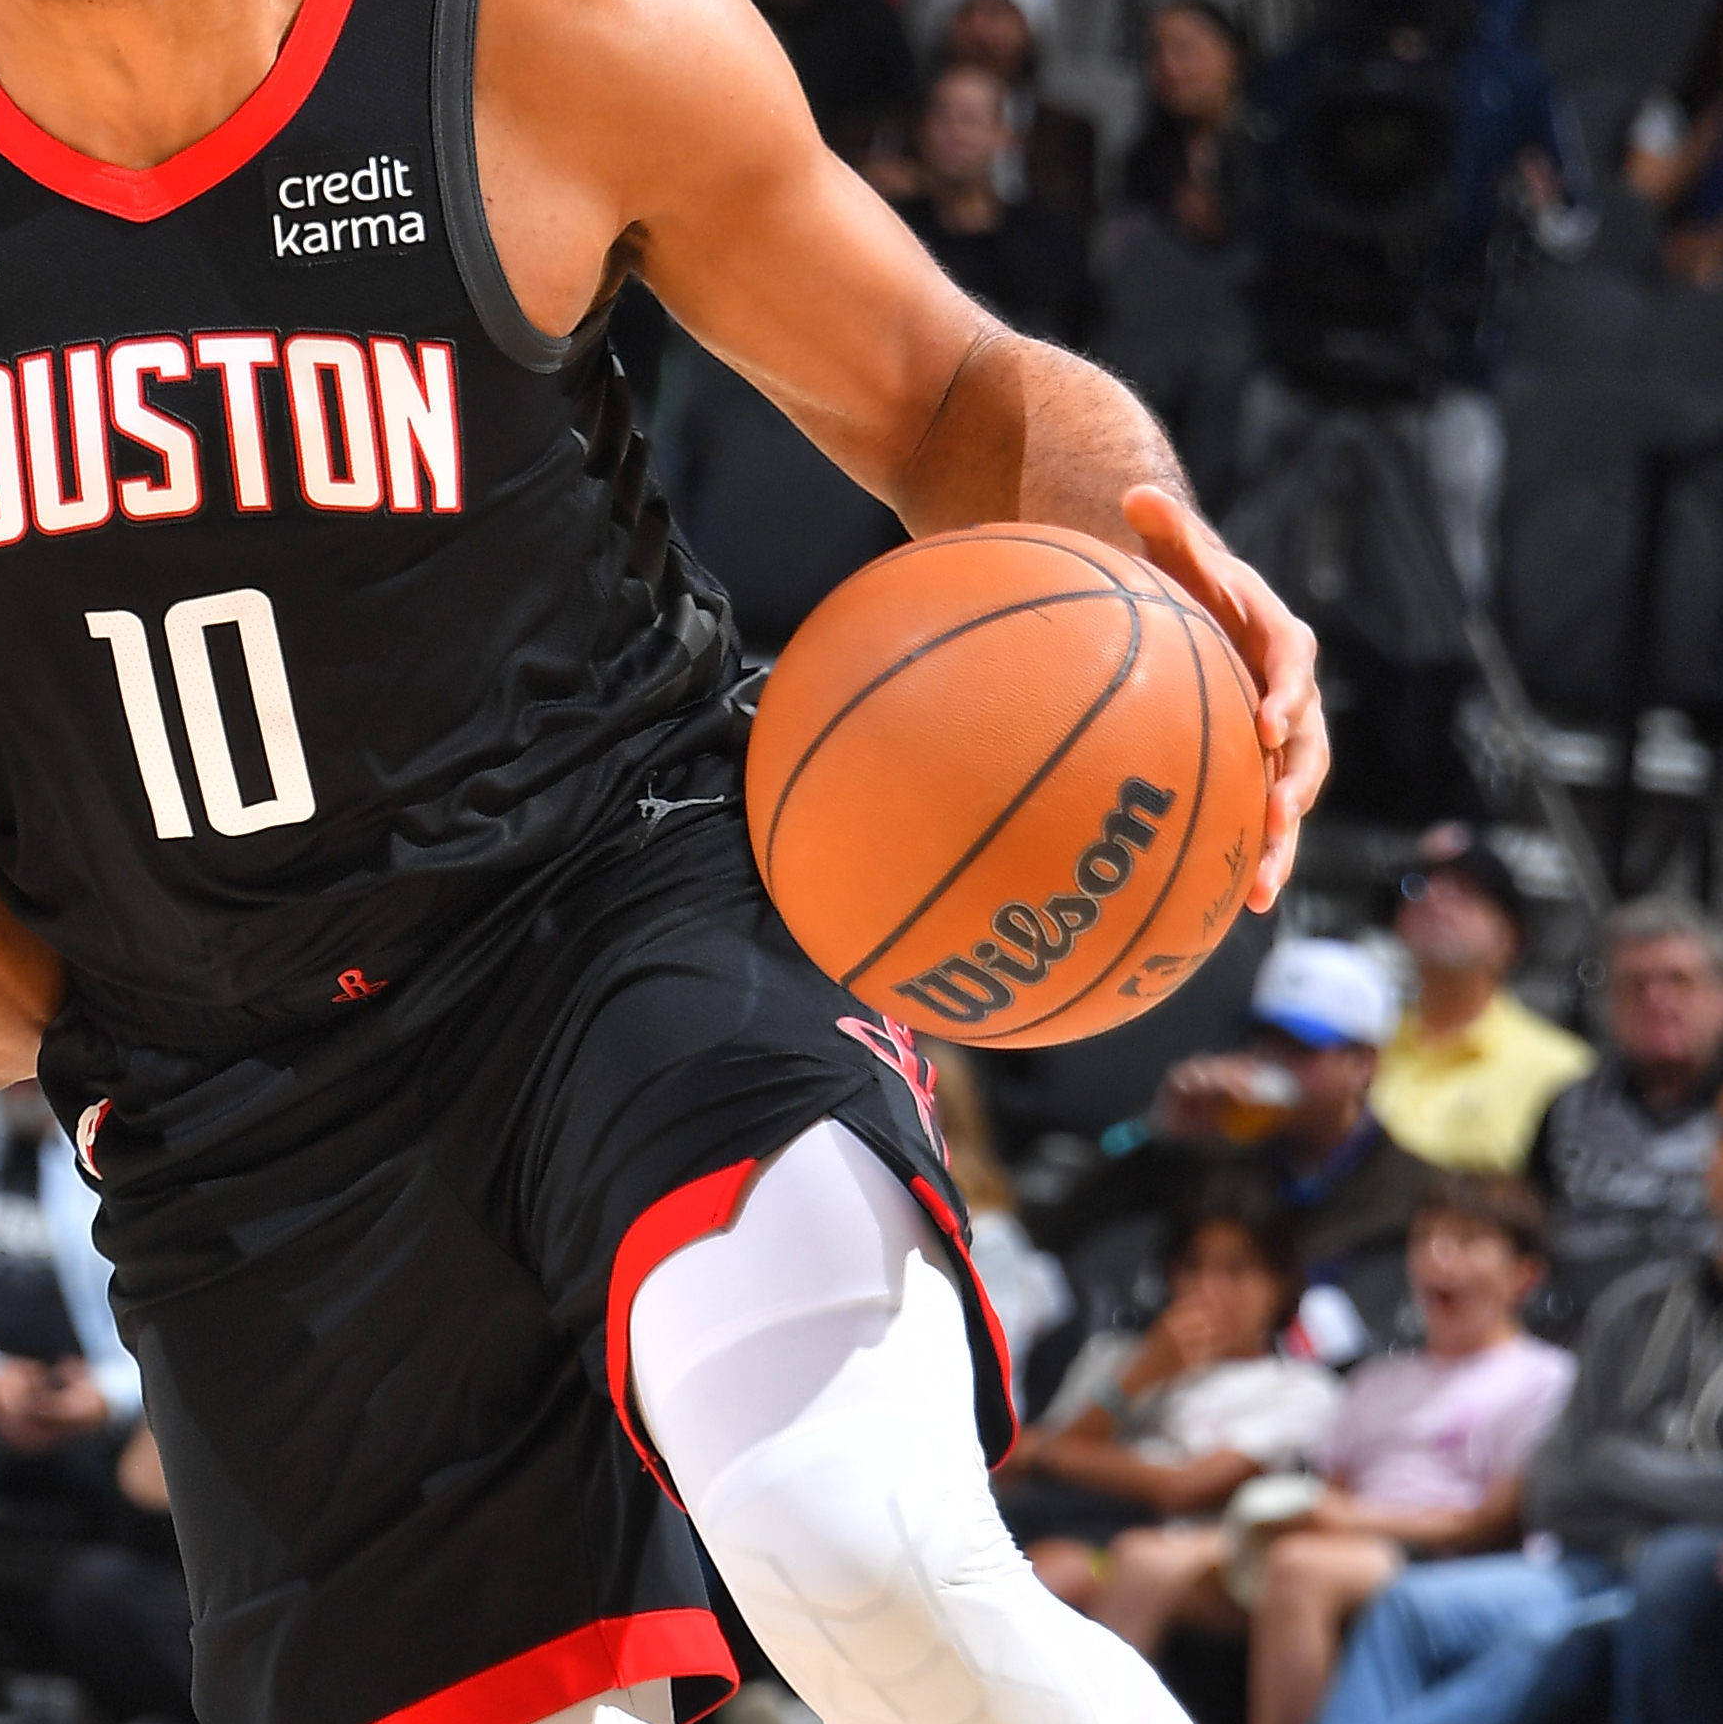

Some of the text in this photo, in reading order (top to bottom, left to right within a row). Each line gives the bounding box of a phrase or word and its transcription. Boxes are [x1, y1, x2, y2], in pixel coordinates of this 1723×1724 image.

[273, 211, 426, 258] karma
[278, 155, 413, 209] credit
[84, 586, 317, 841] 10
[894, 776, 1178, 1023] Wilson
